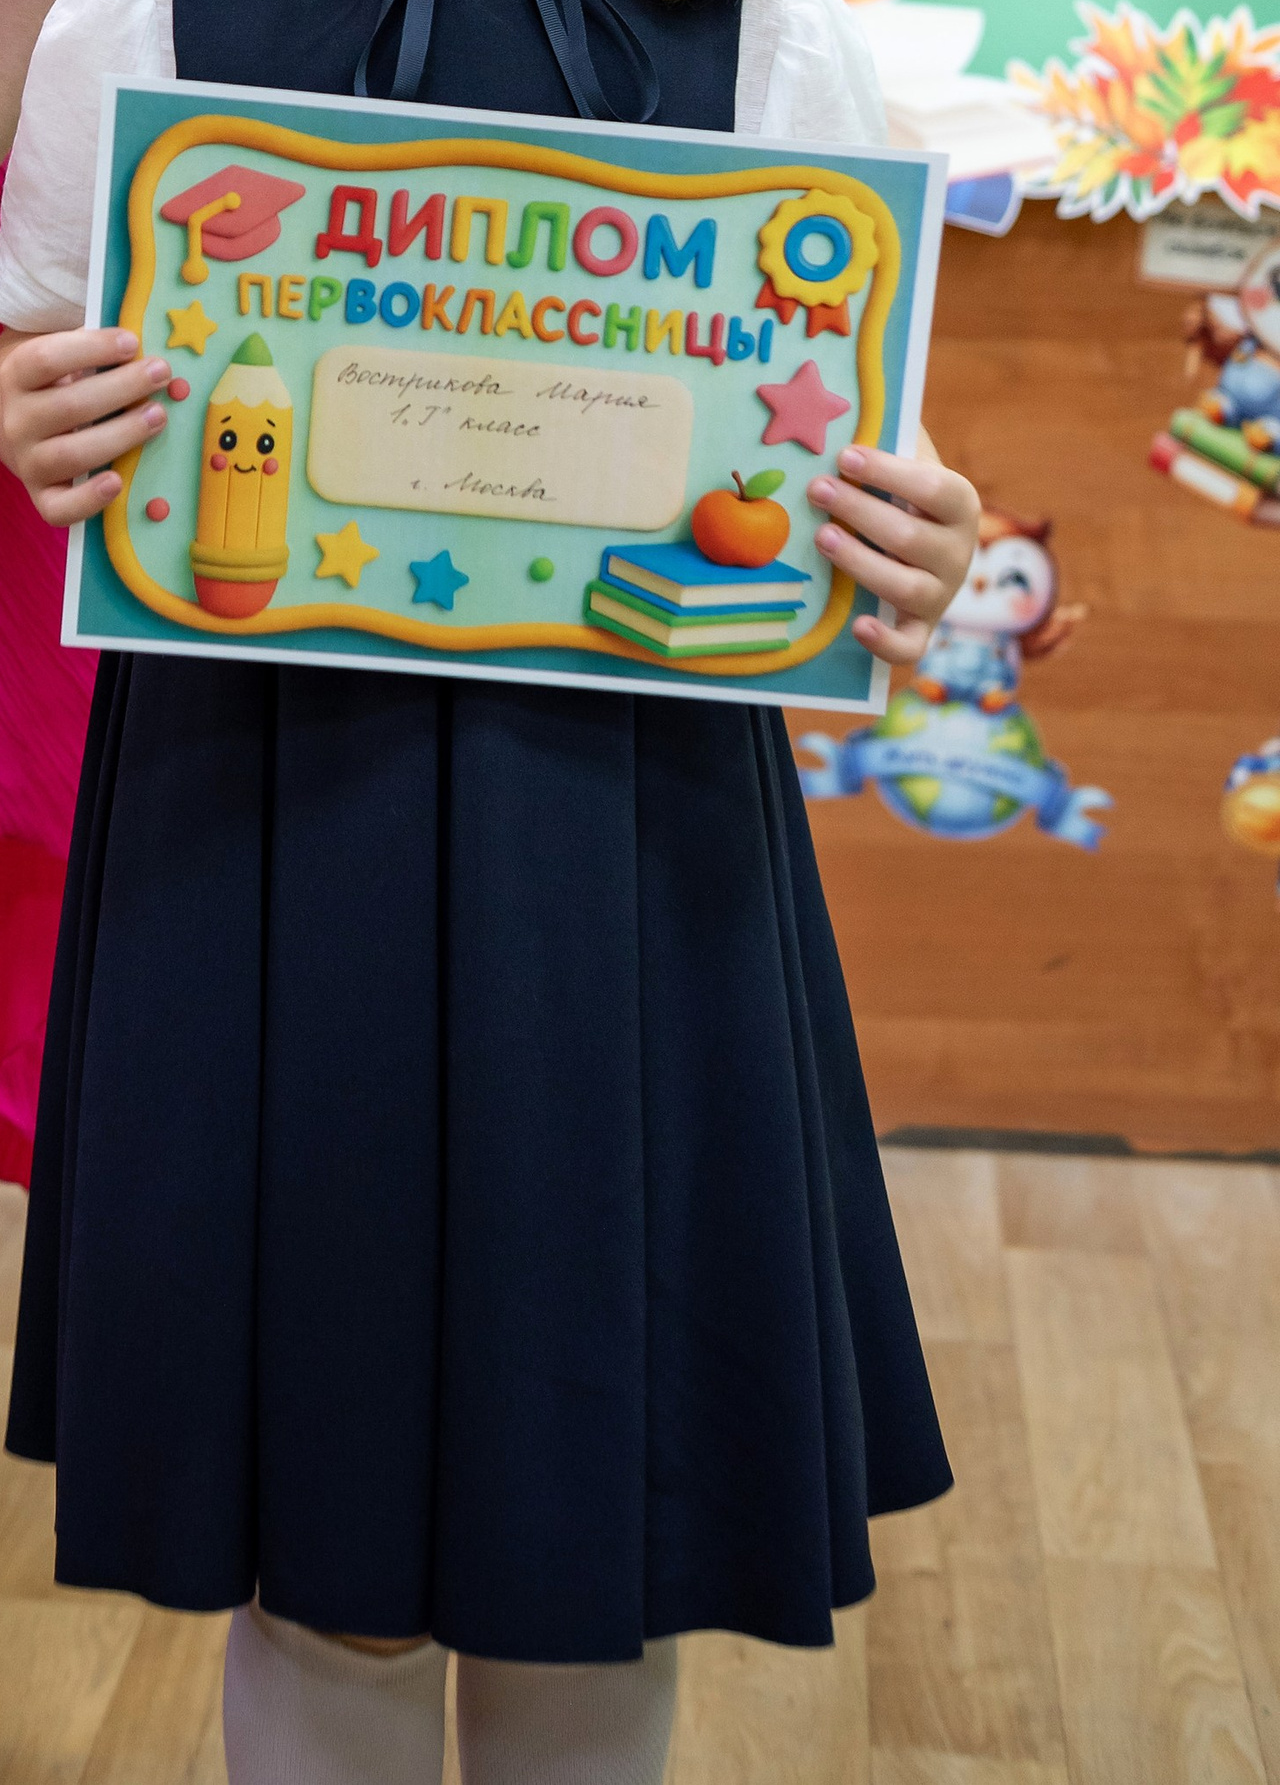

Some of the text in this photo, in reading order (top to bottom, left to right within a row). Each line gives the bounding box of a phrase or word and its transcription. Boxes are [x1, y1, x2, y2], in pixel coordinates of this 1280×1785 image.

[315, 184, 718, 289] ДИПЛОМ
[237, 272, 775, 365] ПЕРВОКЛАССНИЦЫ
[336, 362, 661, 414] Вострикова Мария
[459, 417, 541, 436] класс
[443, 471, 558, 502] Москва
